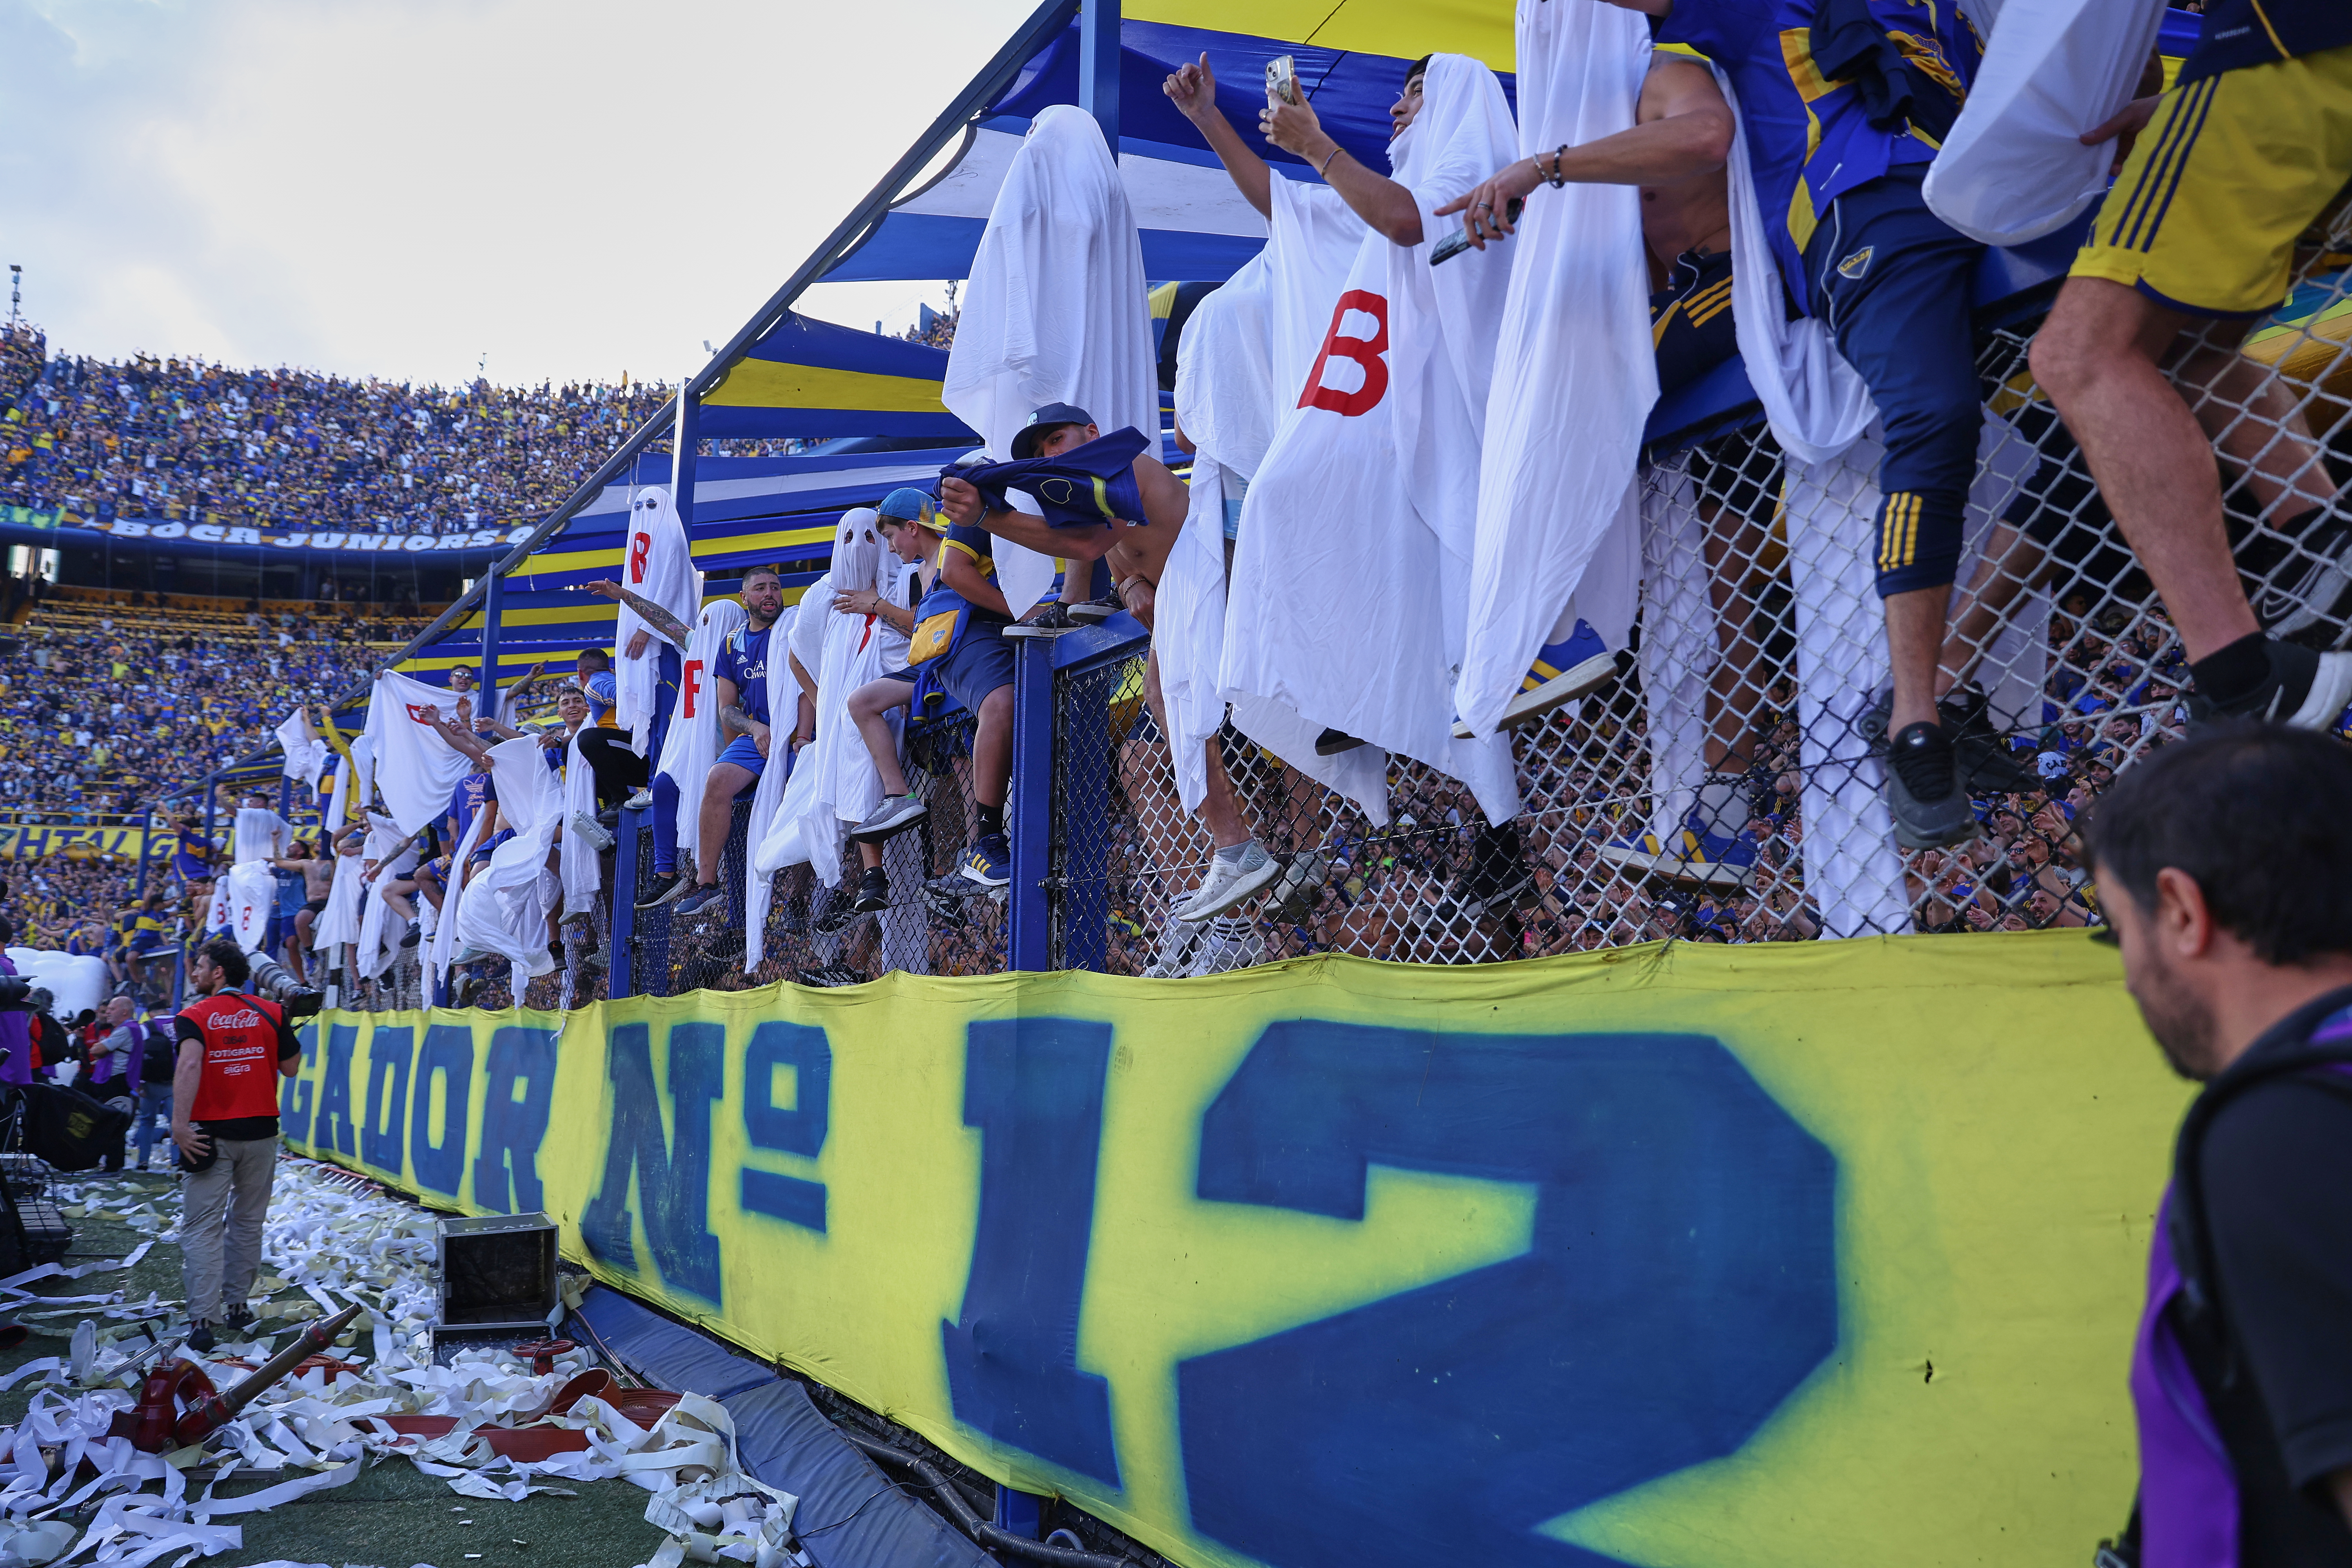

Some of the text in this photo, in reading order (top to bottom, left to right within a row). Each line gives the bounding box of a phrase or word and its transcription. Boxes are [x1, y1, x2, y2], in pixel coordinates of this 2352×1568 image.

[1296, 289, 1389, 417] B
[108, 517, 261, 545] BOCA
[272, 528, 502, 552] JUNIORS
[942, 1016, 1838, 1568] 12
